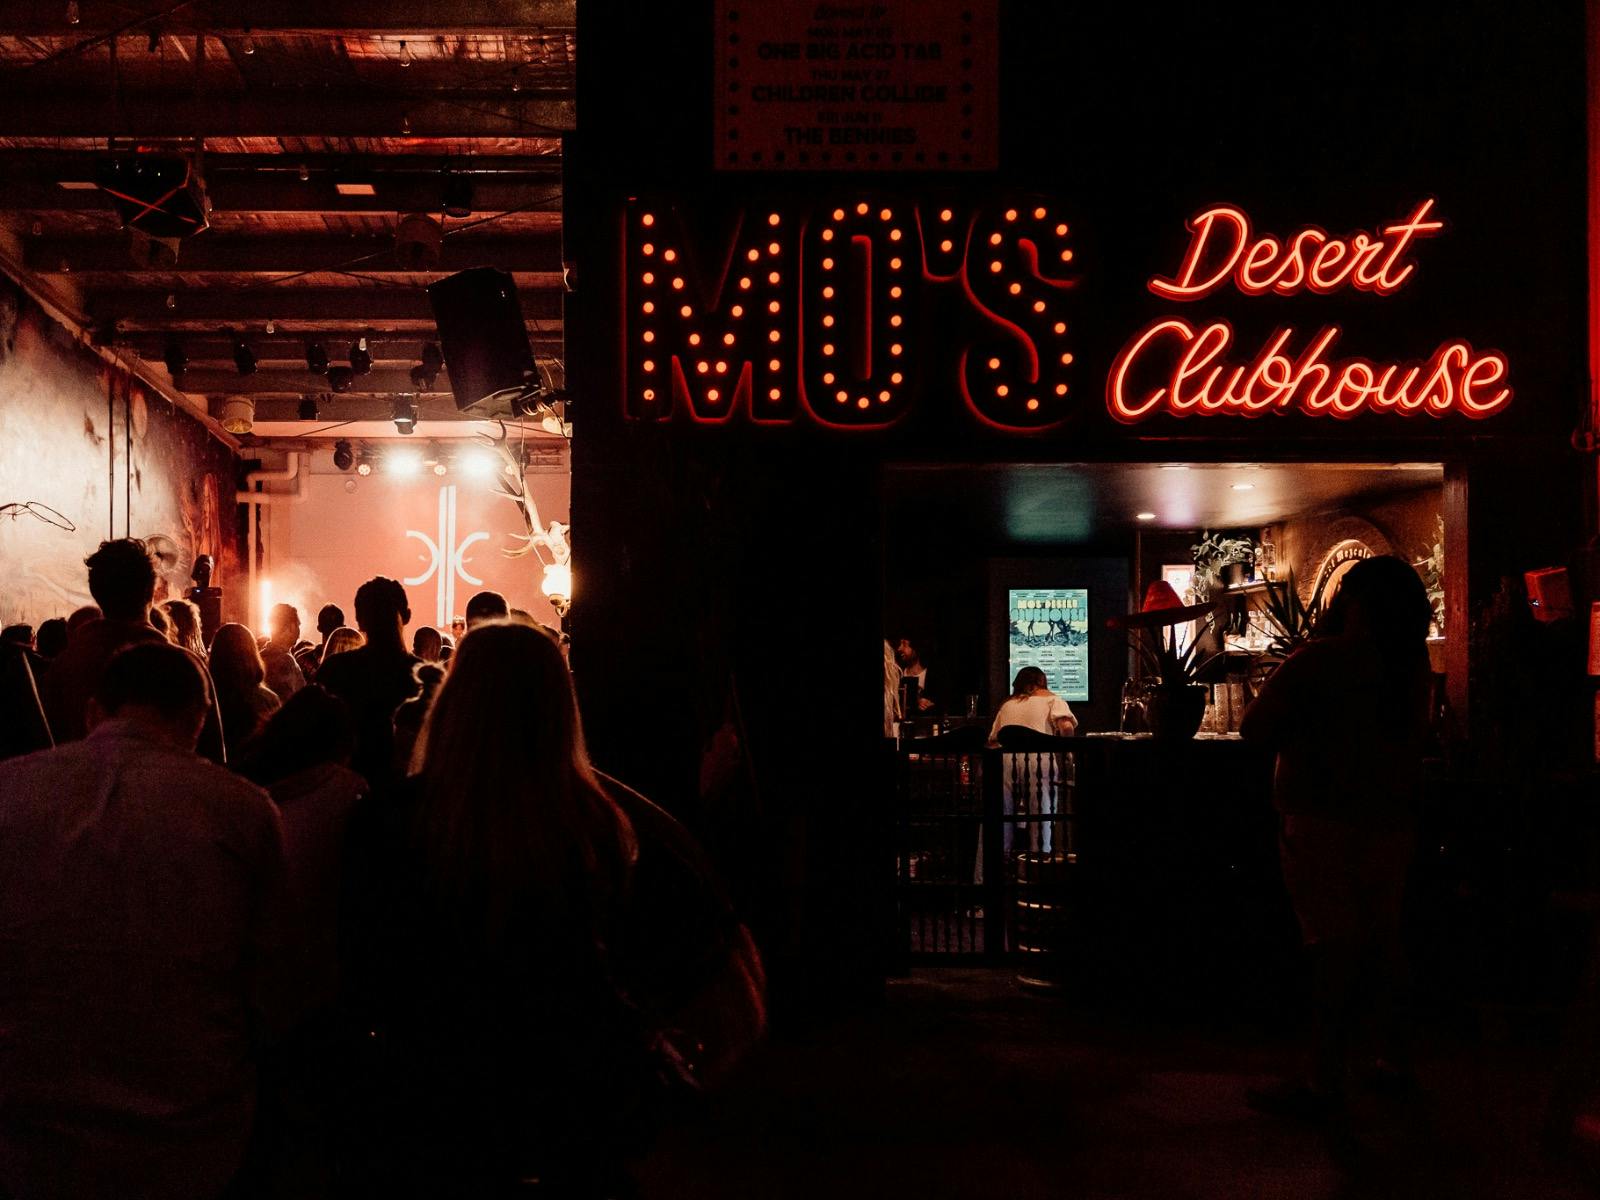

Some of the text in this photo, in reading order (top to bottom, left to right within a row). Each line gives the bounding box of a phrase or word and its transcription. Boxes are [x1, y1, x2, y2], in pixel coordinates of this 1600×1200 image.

[757, 42, 944, 60] ONE BIG ACID TAB
[751, 84, 949, 103] CHILDREN COLLIDE
[785, 127, 918, 144] THE BENNIES
[1149, 198, 1444, 299] Desert
[621, 197, 1080, 432] MO'S
[1109, 317, 1512, 421] Clubhouse
